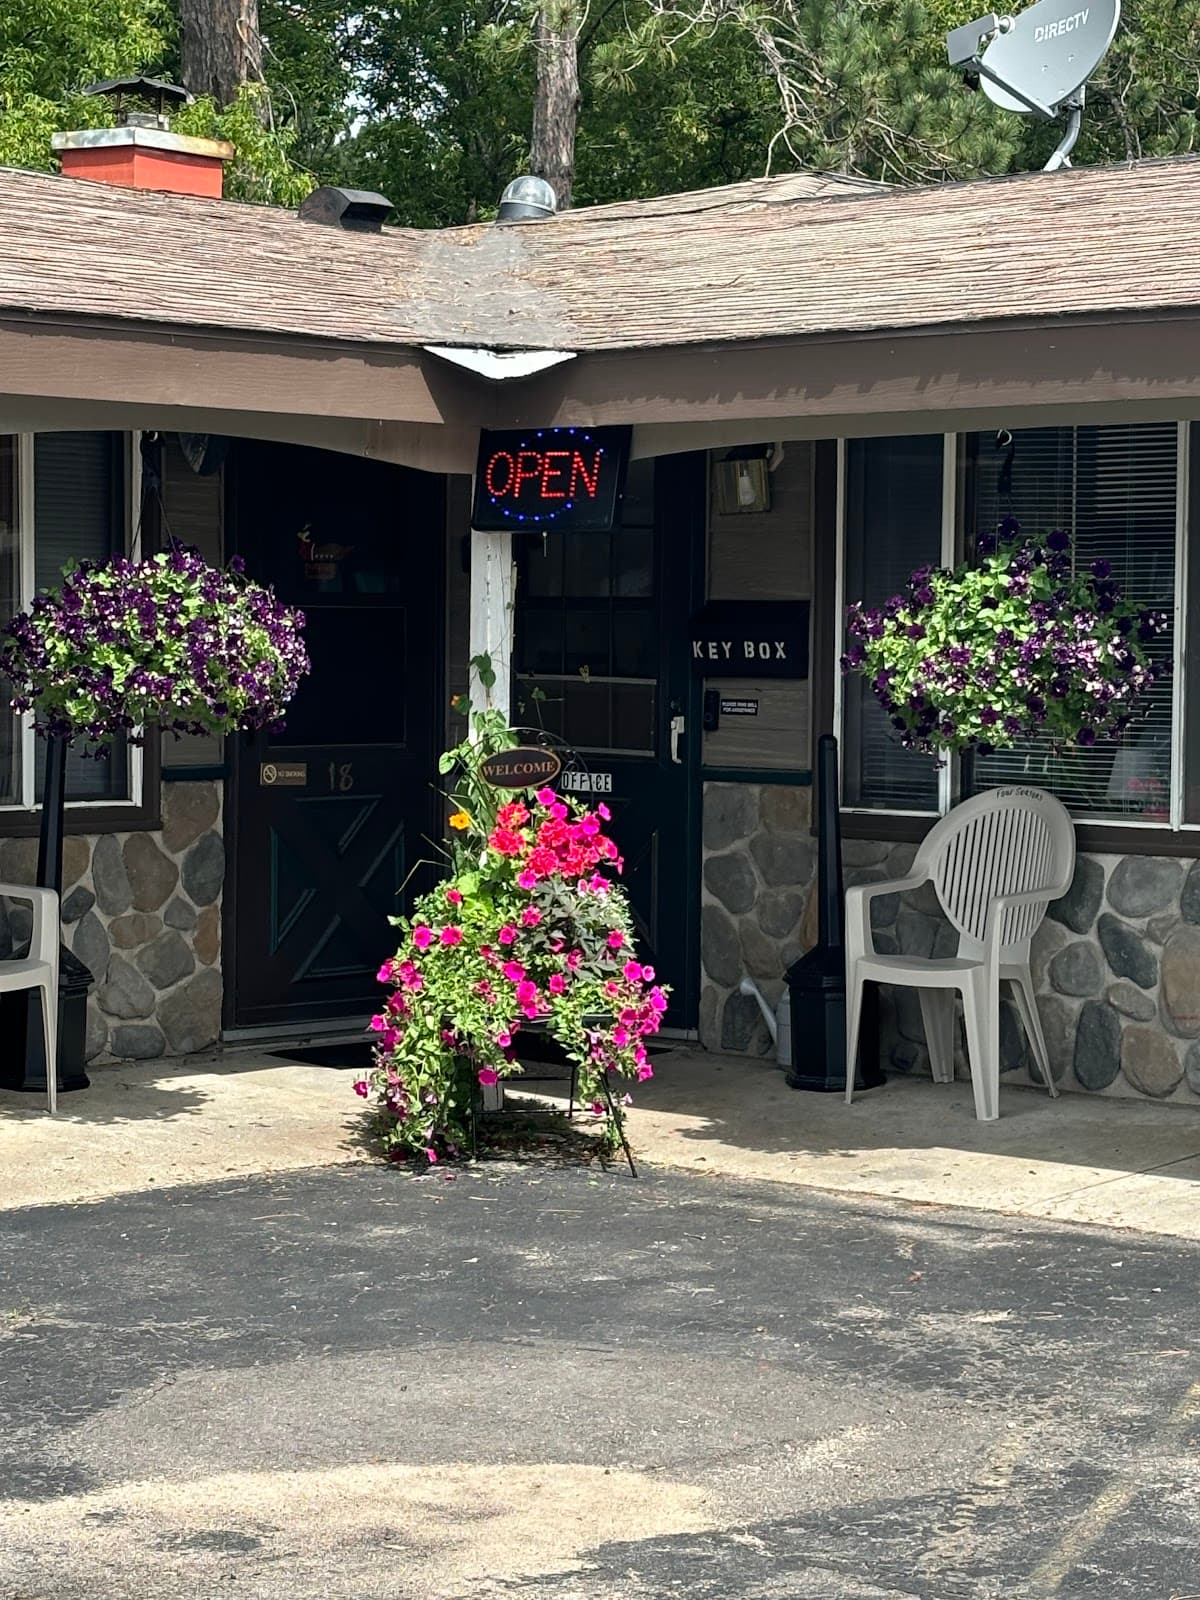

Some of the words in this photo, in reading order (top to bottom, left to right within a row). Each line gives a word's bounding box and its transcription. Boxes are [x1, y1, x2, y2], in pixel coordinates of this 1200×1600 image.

[1034, 8, 1089, 42] DIRECTV
[486, 451, 601, 498] OPEN
[692, 640, 732, 659] KEY
[743, 640, 787, 659] BOX
[329, 761, 353, 791] 18
[482, 760, 556, 777] WELCOME
[562, 771, 611, 792] OFFICE
